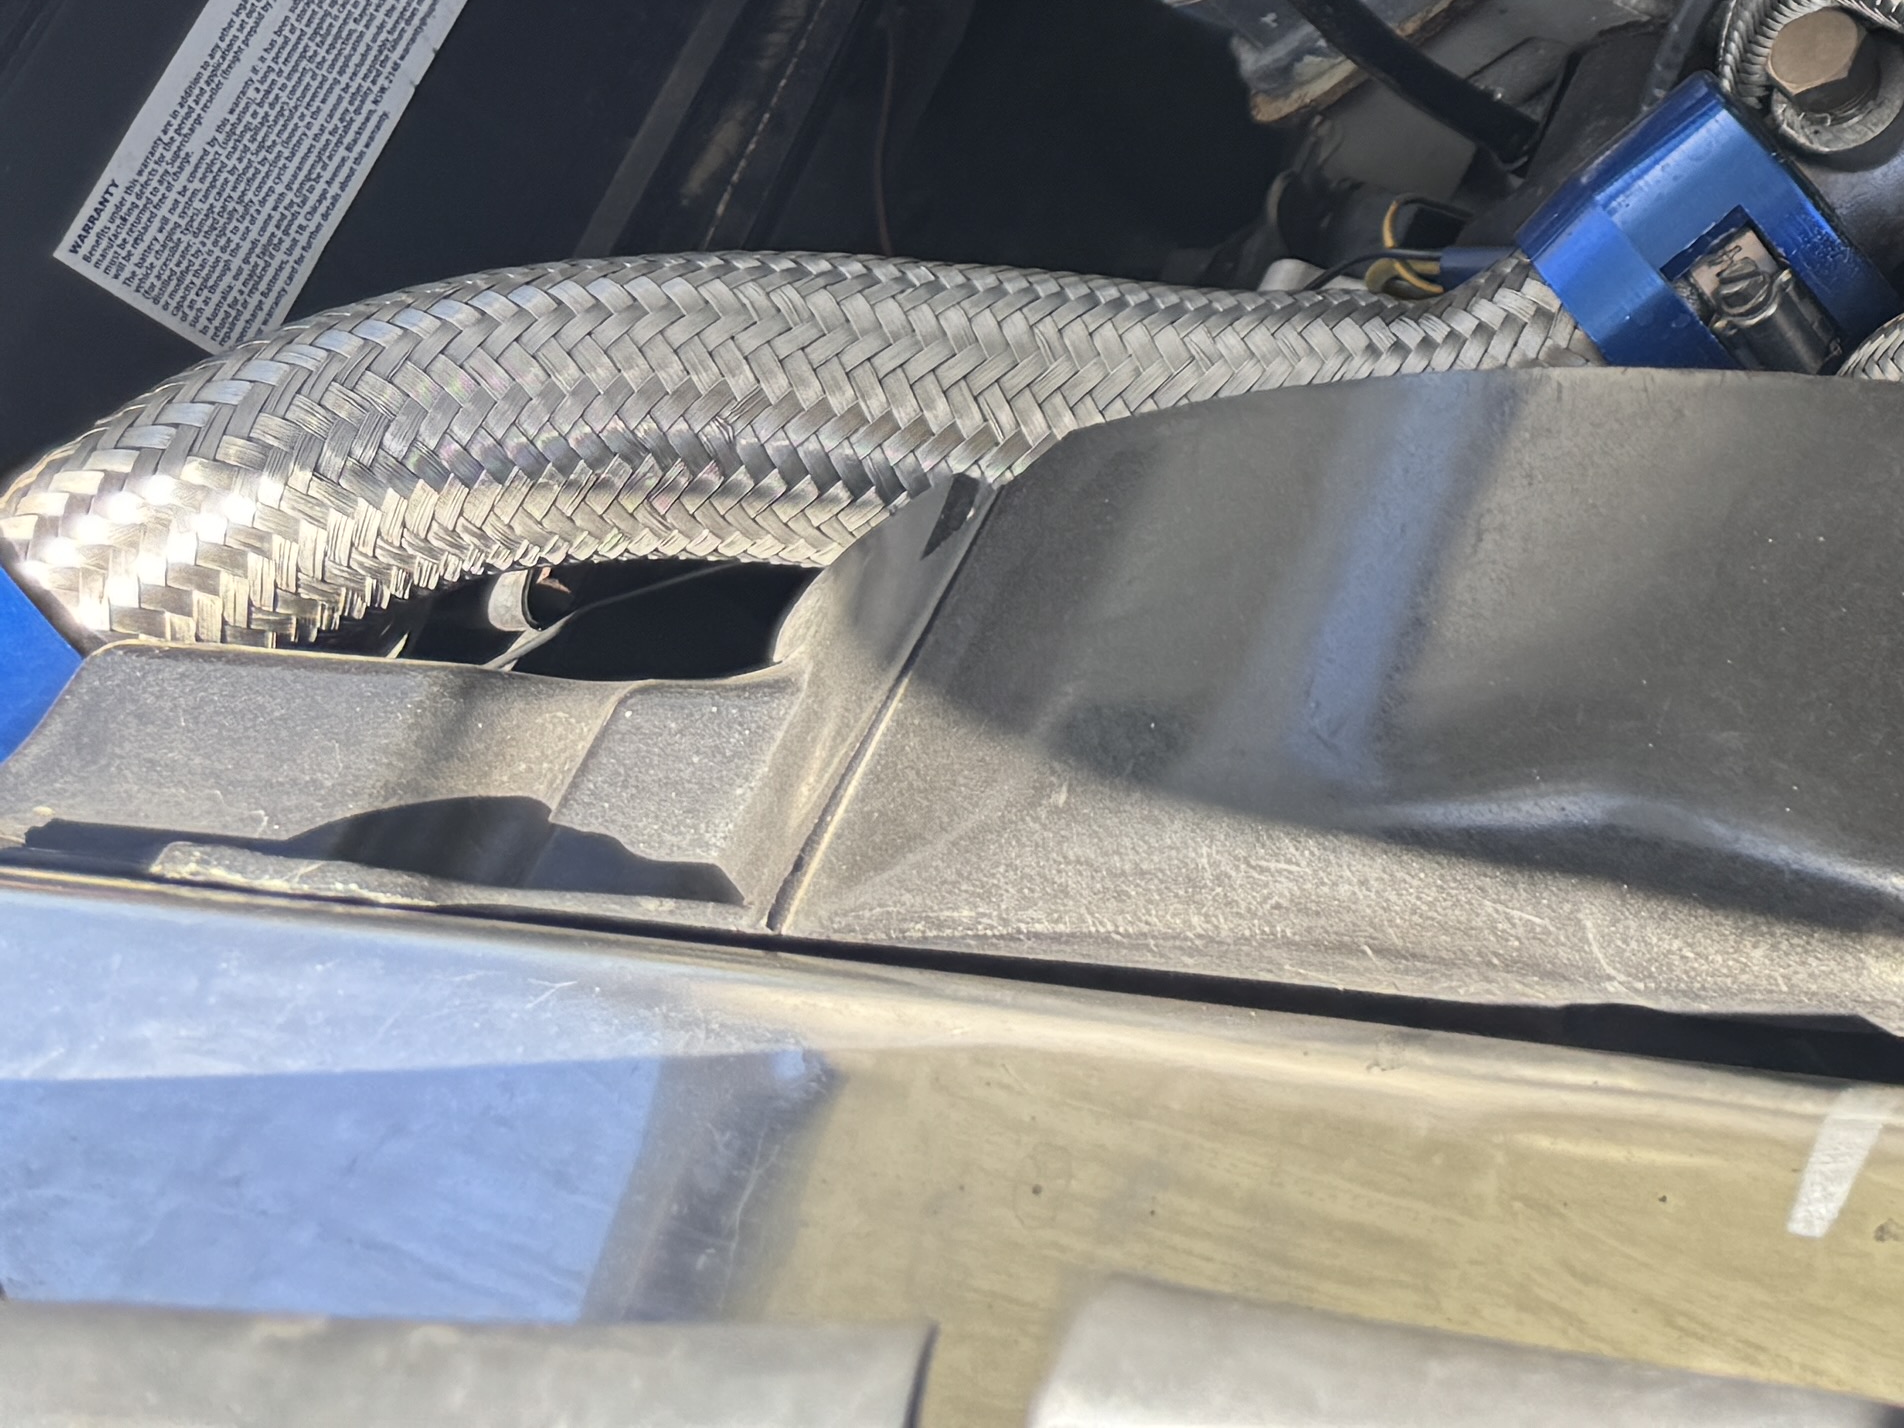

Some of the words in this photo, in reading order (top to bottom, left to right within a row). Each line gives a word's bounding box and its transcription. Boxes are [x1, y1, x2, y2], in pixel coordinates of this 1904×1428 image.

[81, 223, 111, 263] Benefits
[105, 195, 128, 224] under
[122, 176, 139, 196] this
[134, 134, 167, 179] warranty
[160, 119, 174, 135] are
[168, 107, 180, 120] in
[175, 69, 204, 109] addition
[199, 59, 211, 71] to
[206, 42, 224, 62] any
[216, 16, 237, 43] other
[101, 249, 122, 275] must
[116, 235, 129, 250] be
[123, 195, 154, 237] returned
[149, 185, 160, 197] to
[155, 167, 172, 187] any
[164, 111, 206, 169] Supercharge
[198, 78, 225, 114] reseller
[218, 44, 247, 81] (freight
[239, 10, 268, 48] prepaid
[260, 0, 274, 14] by
[133, 166, 159, 201] defects
[153, 152, 167, 167] for
[162, 134, 177, 152] the
[171, 103, 197, 136] period
[190, 85, 207, 106] and
[201, 32, 242, 88] applications
[235, 18, 249, 34] set
[244, 2, 259, 19] out
[67, 178, 121, 256] WARRANTY
[121, 268, 139, 288] The
[132, 233, 161, 270] battery
[153, 214, 171, 234] will
[165, 196, 181, 215] not
[176, 182, 190, 197] be
[205, 133, 221, 149] by
[213, 114, 230, 135] this
[225, 75, 256, 117] warranty
[151, 190, 169, 211] free
[162, 179, 175, 192] of
[168, 148, 196, 183] charge.
[110, 261, 126, 280] will
[121, 247, 134, 262] be
[127, 209, 160, 250] replaced
[198, 323, 210, 336] In
[231, 265, 246, 282] our
[239, 236, 263, 266] goods
[255, 212, 276, 237] come
[269, 190, 288, 213] with
[282, 142, 319, 192] guarantees
[227, 298, 267, 352] percharge
[283, 236, 300, 257] Unit
[301, 185, 332, 223] Chicago
[257, 285, 289, 327] warranty
[281, 265, 300, 287] card
[292, 251, 306, 266] for
[299, 220, 325, 253] further
[317, 190, 342, 222] details
[335, 164, 358, 192] about
[350, 147, 367, 167] this
